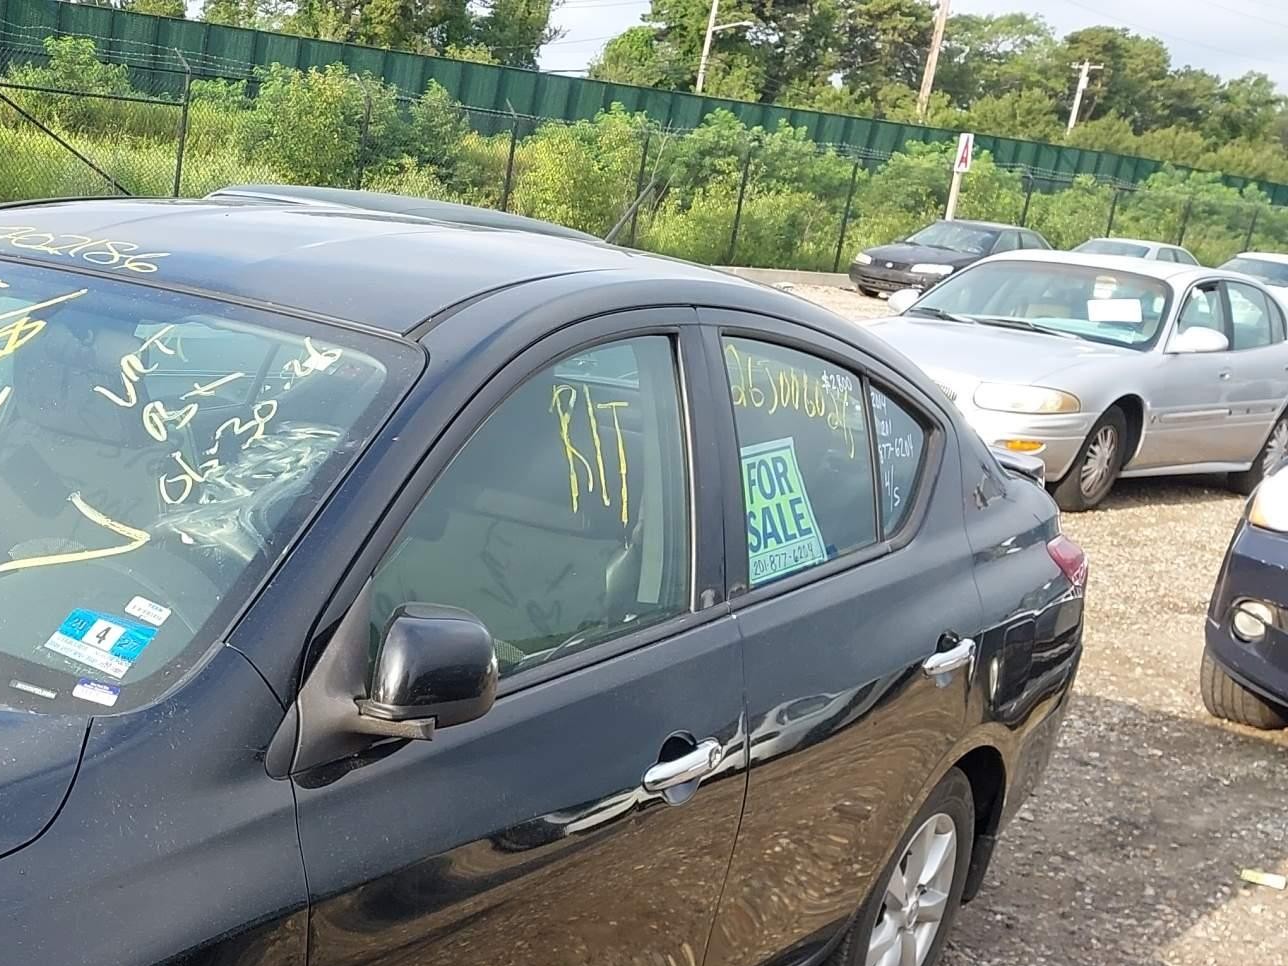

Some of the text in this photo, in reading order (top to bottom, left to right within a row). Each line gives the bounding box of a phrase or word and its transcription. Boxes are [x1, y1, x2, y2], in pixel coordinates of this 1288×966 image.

[958, 136, 969, 168] A
[822, 370, 852, 394] $2,800
[747, 456, 793, 504] FOR
[748, 496, 812, 553] SALE
[96, 627, 111, 644] 4
